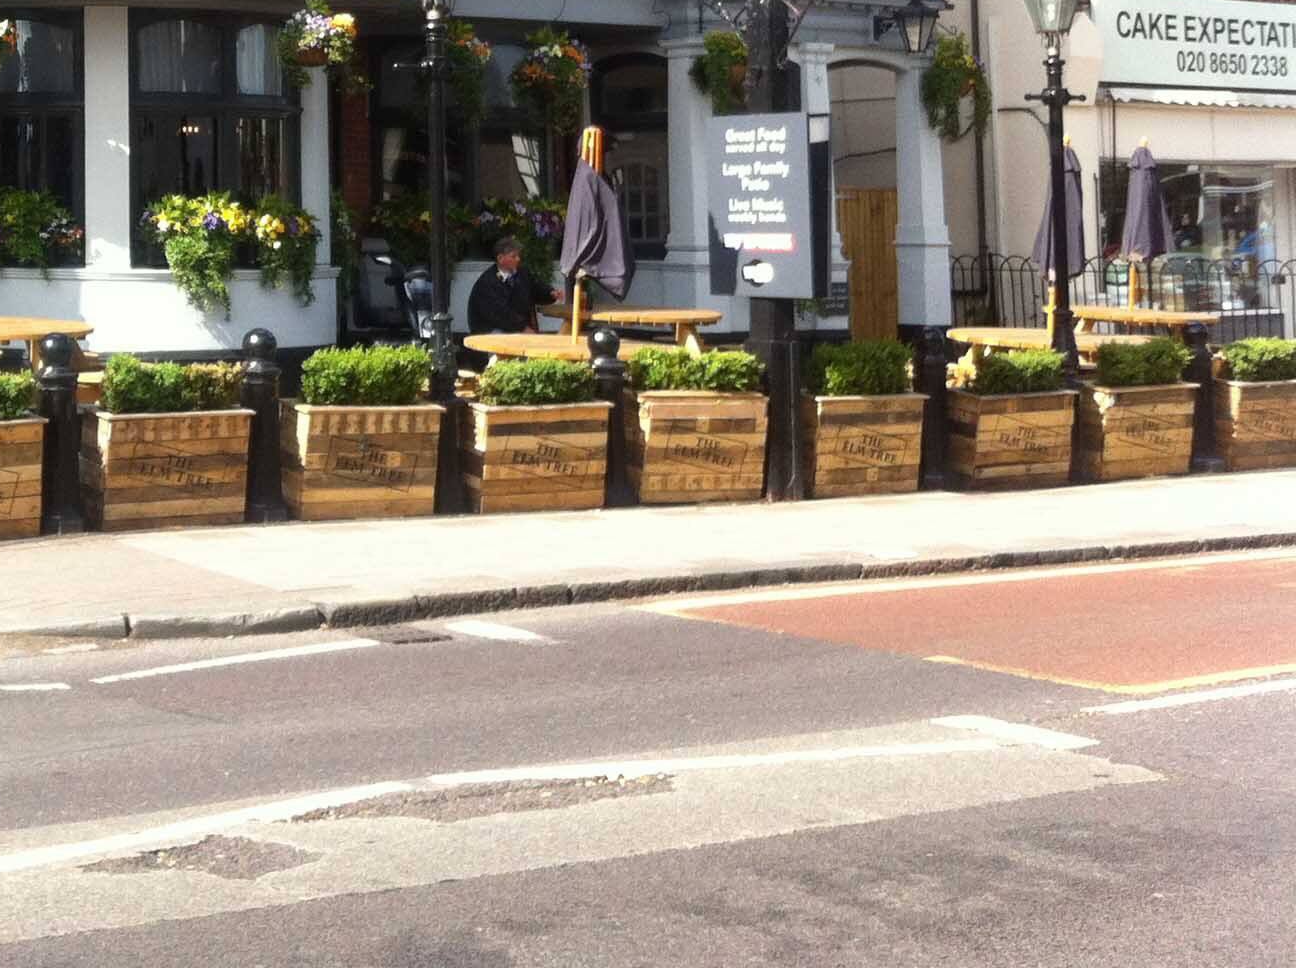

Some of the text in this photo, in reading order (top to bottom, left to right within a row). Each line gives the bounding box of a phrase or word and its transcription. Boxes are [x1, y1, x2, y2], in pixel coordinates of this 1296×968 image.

[1116, 11, 1178, 41] CAKE
[1177, 50, 1288, 77] 020 8650 2338
